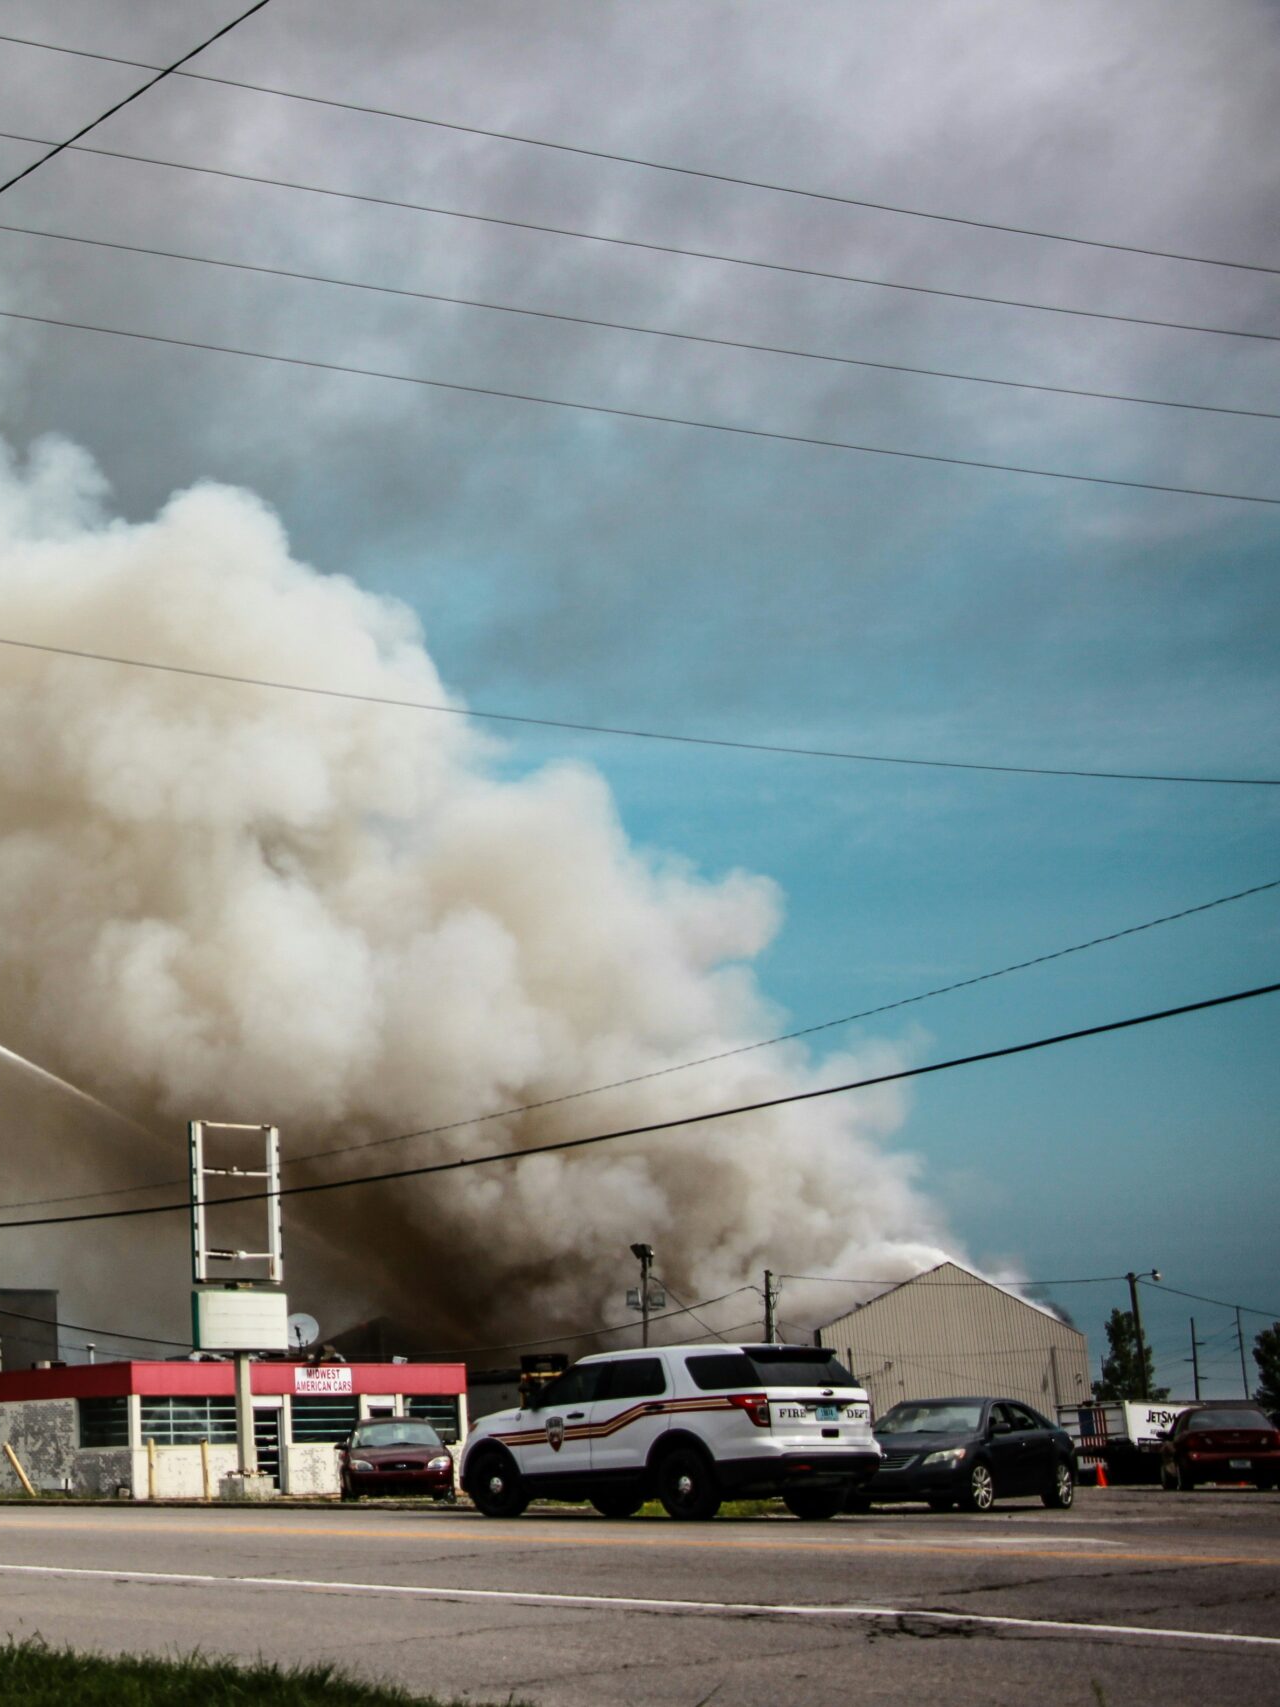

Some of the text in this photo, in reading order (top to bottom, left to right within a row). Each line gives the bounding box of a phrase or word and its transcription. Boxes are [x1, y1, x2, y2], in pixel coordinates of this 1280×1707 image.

[306, 1369, 340, 1379] MIDWEST
[296, 1381, 352, 1391] AMERICAN CARS
[779, 1408, 869, 1419] FIRE DEPT
